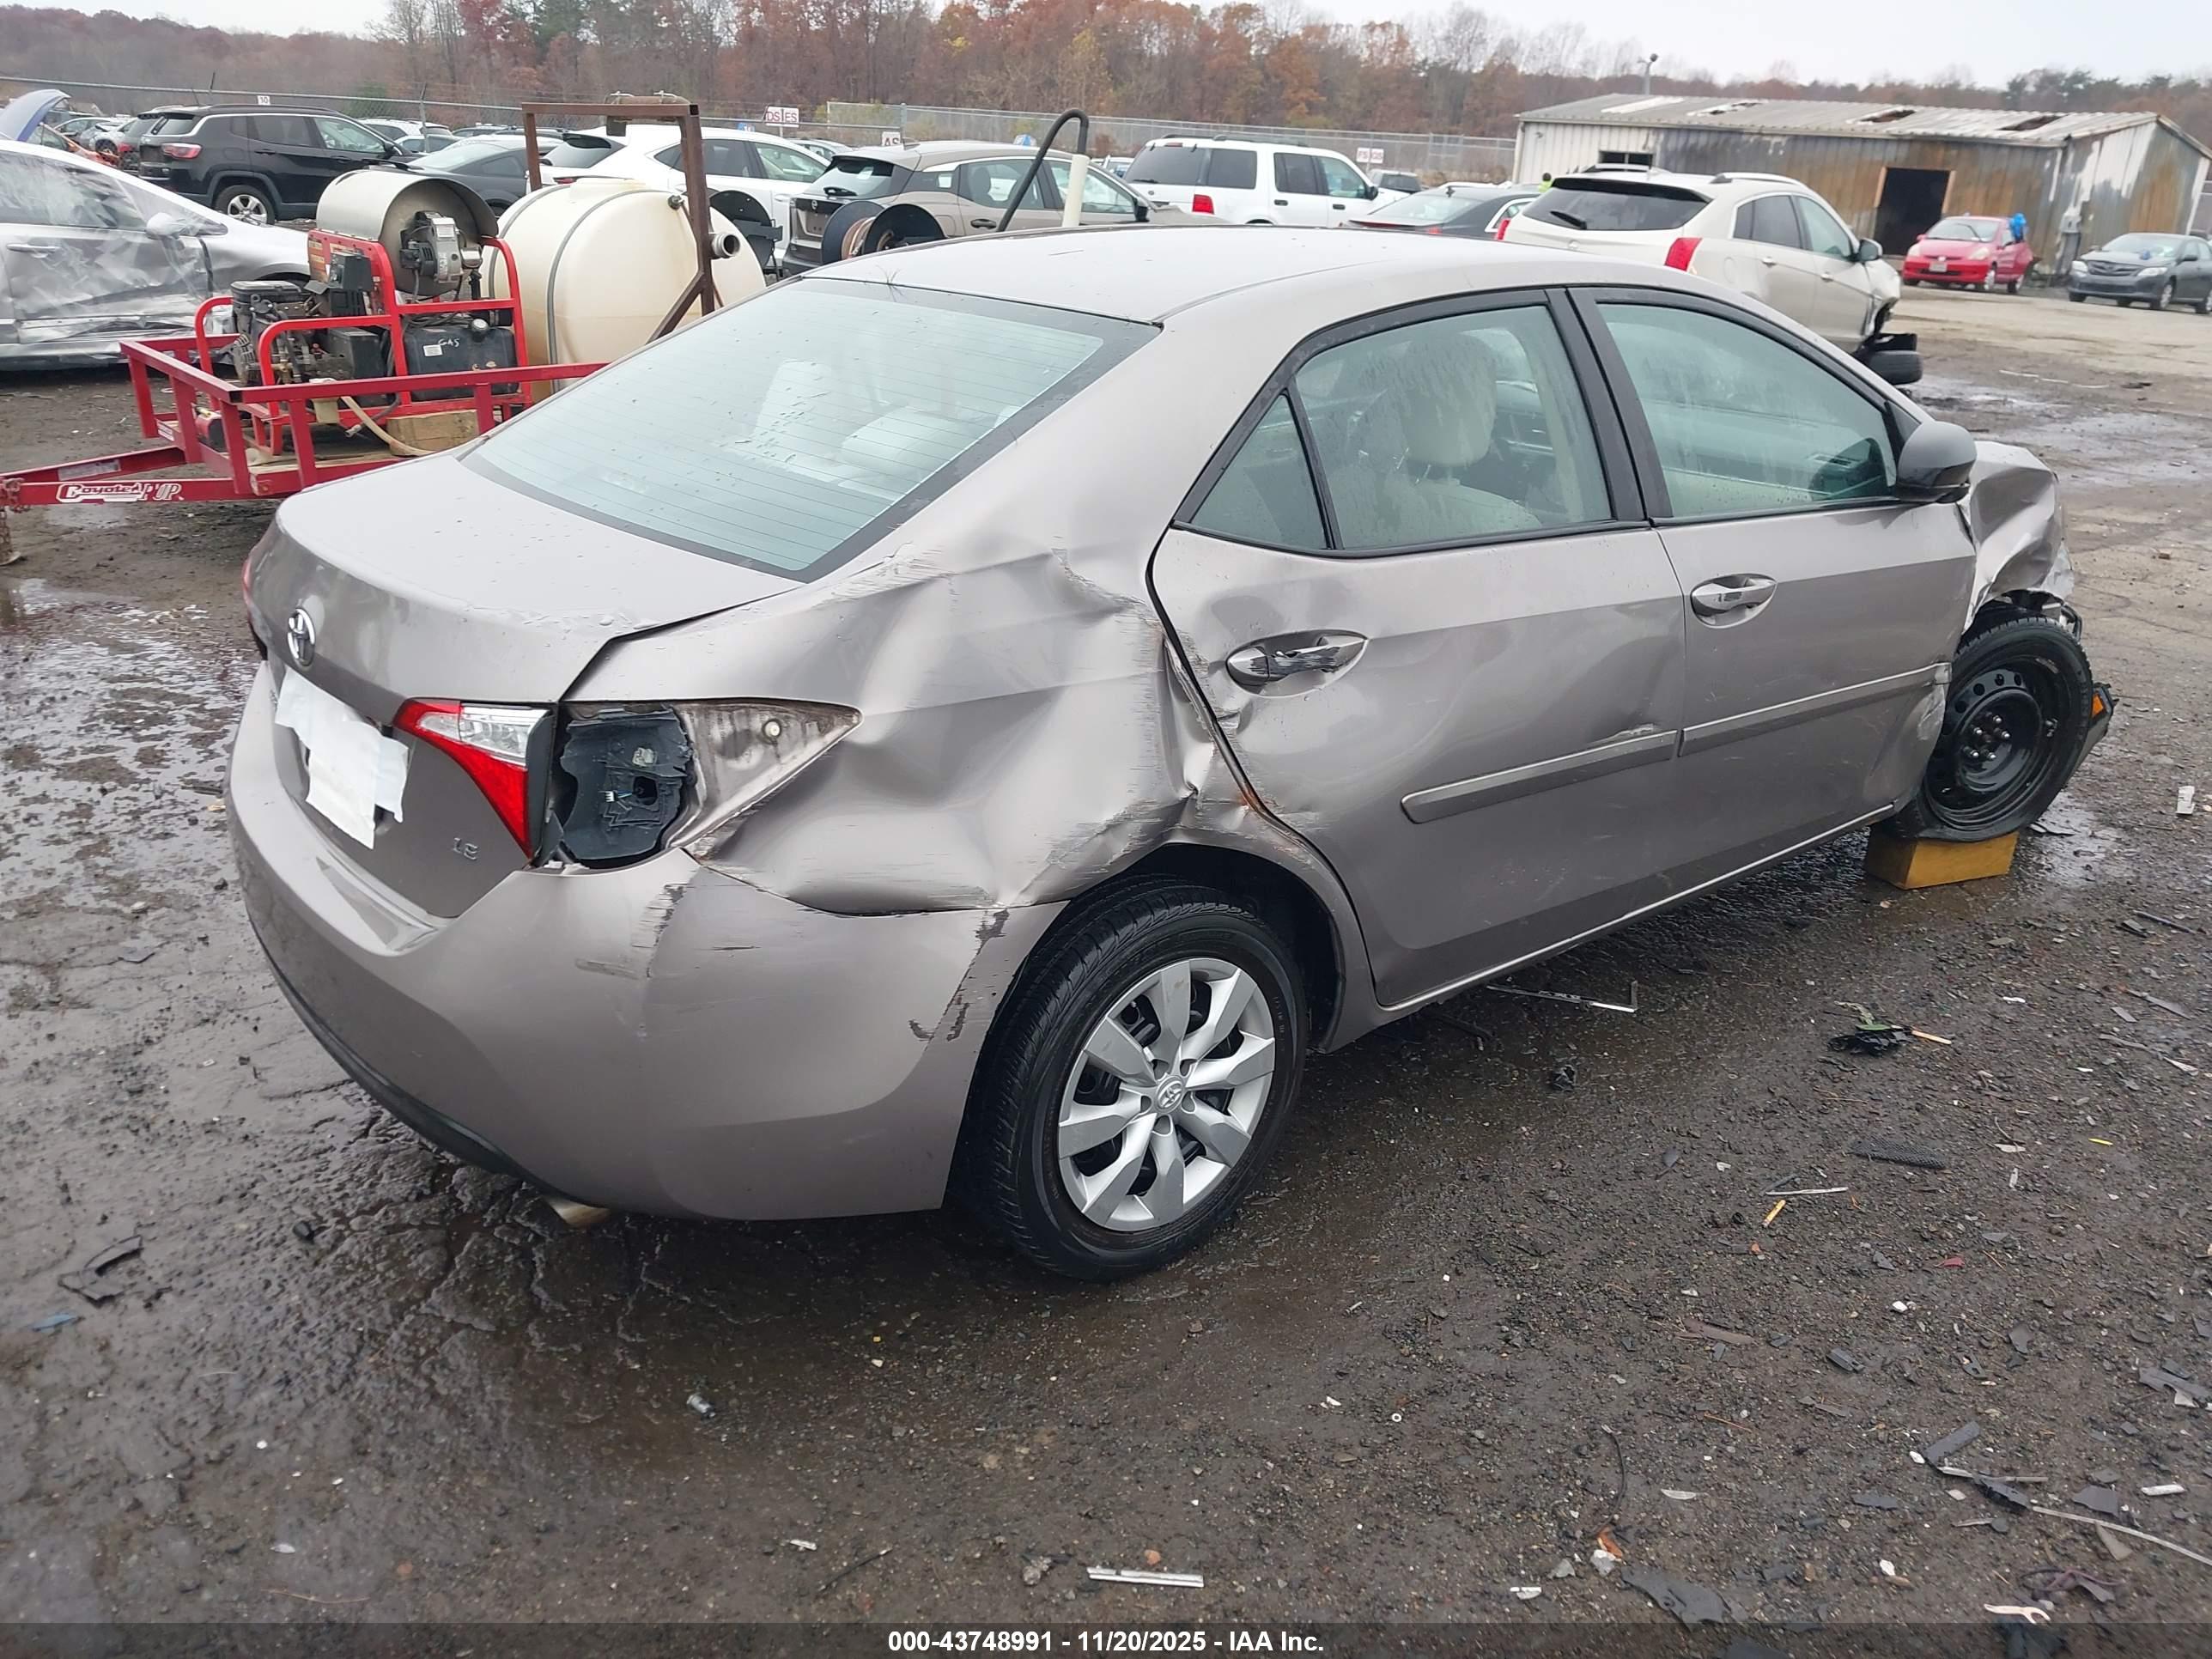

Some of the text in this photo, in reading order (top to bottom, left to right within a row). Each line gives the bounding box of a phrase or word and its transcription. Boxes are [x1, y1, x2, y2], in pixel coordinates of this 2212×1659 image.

[766, 111, 798, 122] DS ES
[884, 137, 901, 146] AS
[438, 338, 460, 348] GAS
[56, 483, 136, 502] Coyote
[453, 837, 478, 860] LE
